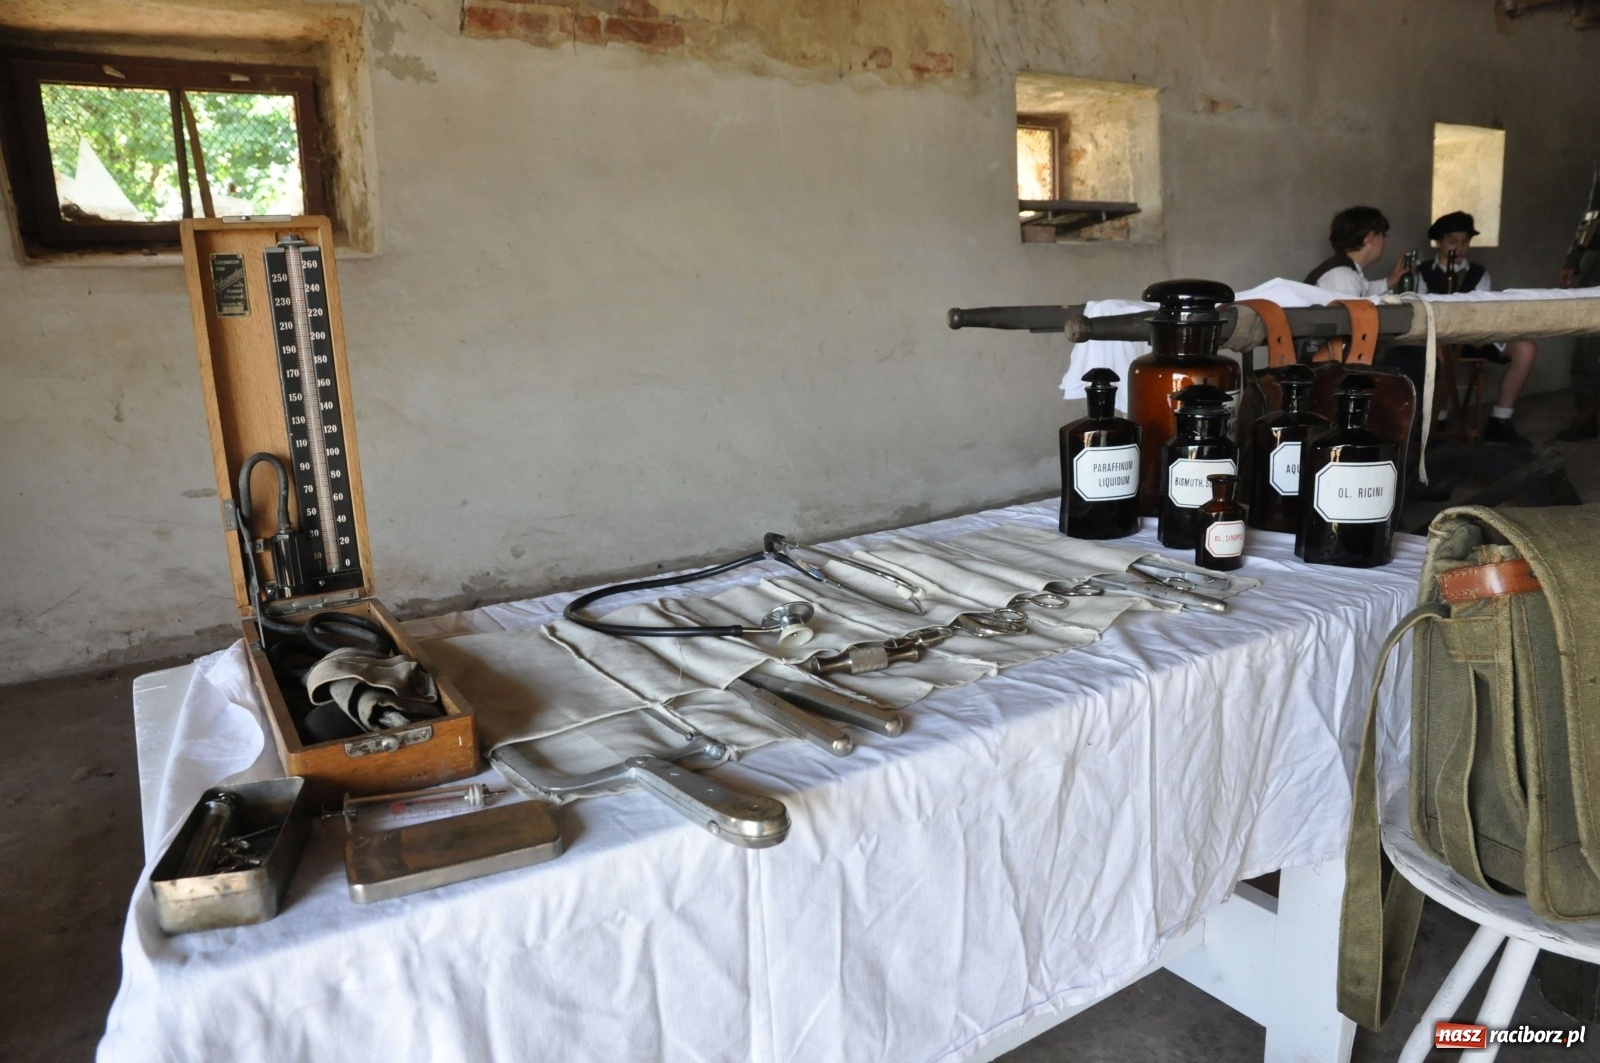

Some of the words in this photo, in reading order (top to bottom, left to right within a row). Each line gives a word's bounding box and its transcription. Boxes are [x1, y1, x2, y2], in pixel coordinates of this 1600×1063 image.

[302, 260, 317, 268] 260
[272, 274, 287, 282] 250
[305, 284, 320, 292] 240
[275, 298, 290, 306] 230
[280, 322, 293, 330] 210
[310, 332, 325, 340] 200
[282, 346, 296, 354] 190
[314, 356, 327, 364] 180
[286, 369, 299, 378] 170
[317, 379, 330, 387] 160
[289, 393, 302, 401] 150
[320, 402, 333, 410] 140
[292, 416, 305, 424] 130
[324, 425, 337, 433] 120
[296, 439, 307, 447] 110
[326, 448, 339, 456] 100
[300, 462, 310, 470] 90
[1093, 460, 1132, 472] PARAFFINUM
[331, 470, 341, 478] 80
[1098, 475, 1130, 488] LIQUIDUM
[1175, 477, 1204, 487] BISMUTH.
[304, 485, 313, 493] 70
[1338, 488, 1352, 498] OL.
[1358, 486, 1383, 498] RICINI
[333, 493, 343, 501] 60
[307, 508, 316, 516] 50
[337, 515, 346, 523] 40
[314, 552, 322, 560] 10
